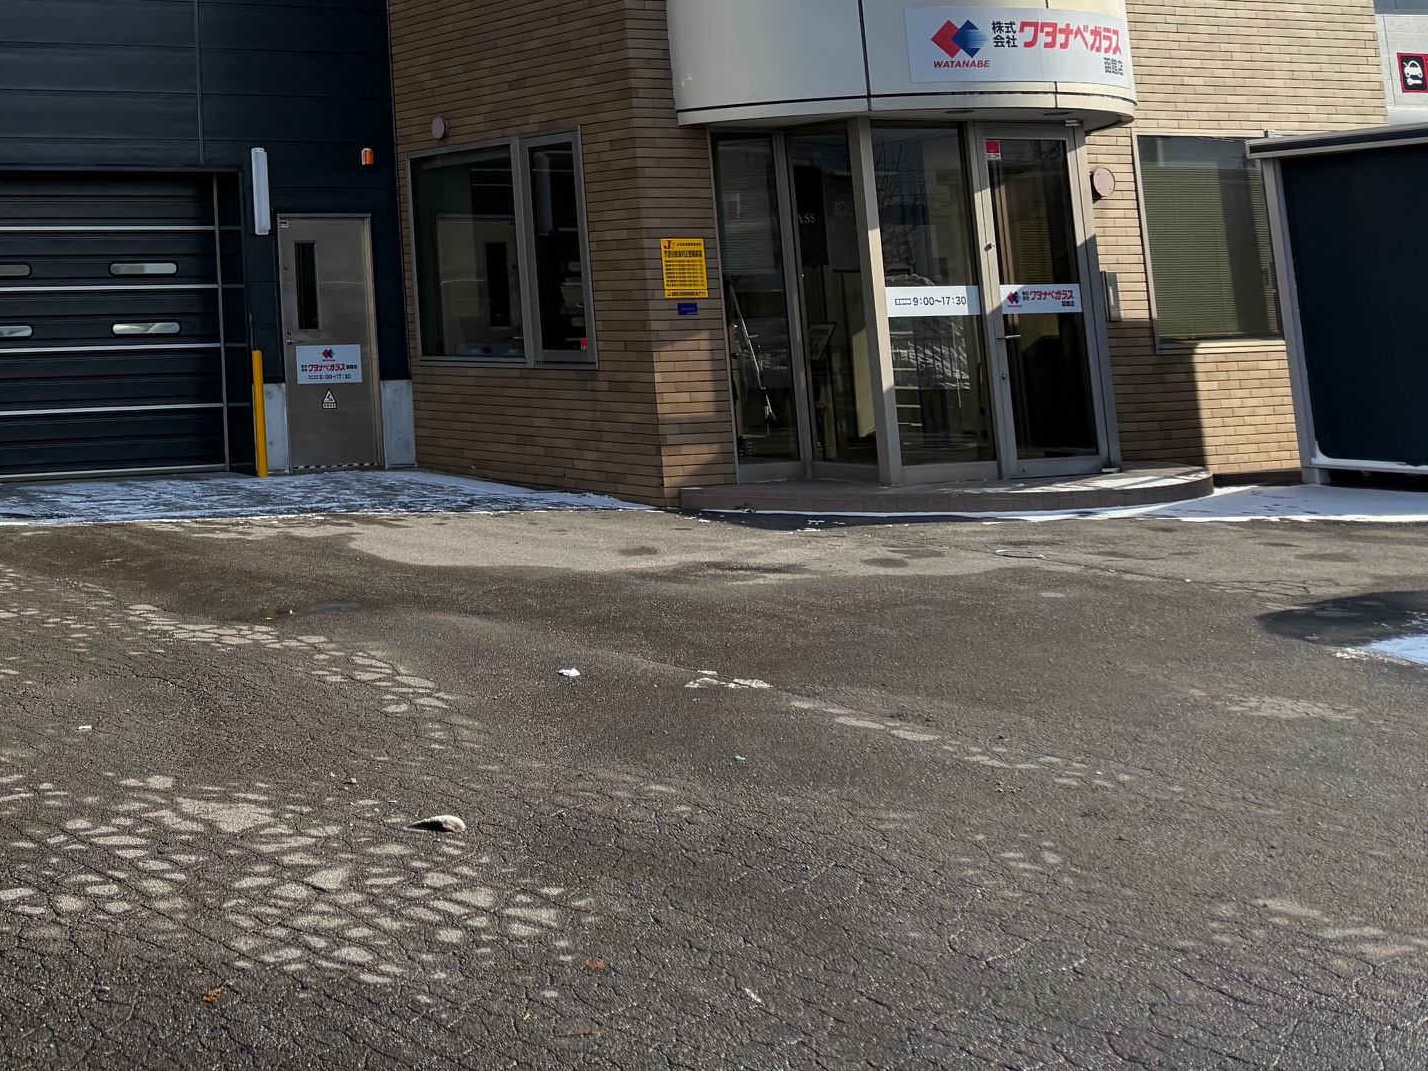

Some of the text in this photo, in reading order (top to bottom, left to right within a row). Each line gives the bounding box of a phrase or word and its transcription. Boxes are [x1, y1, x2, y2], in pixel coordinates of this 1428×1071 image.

[1018, 20, 1123, 56] ワタナベガラス
[933, 59, 991, 69] WATANABE
